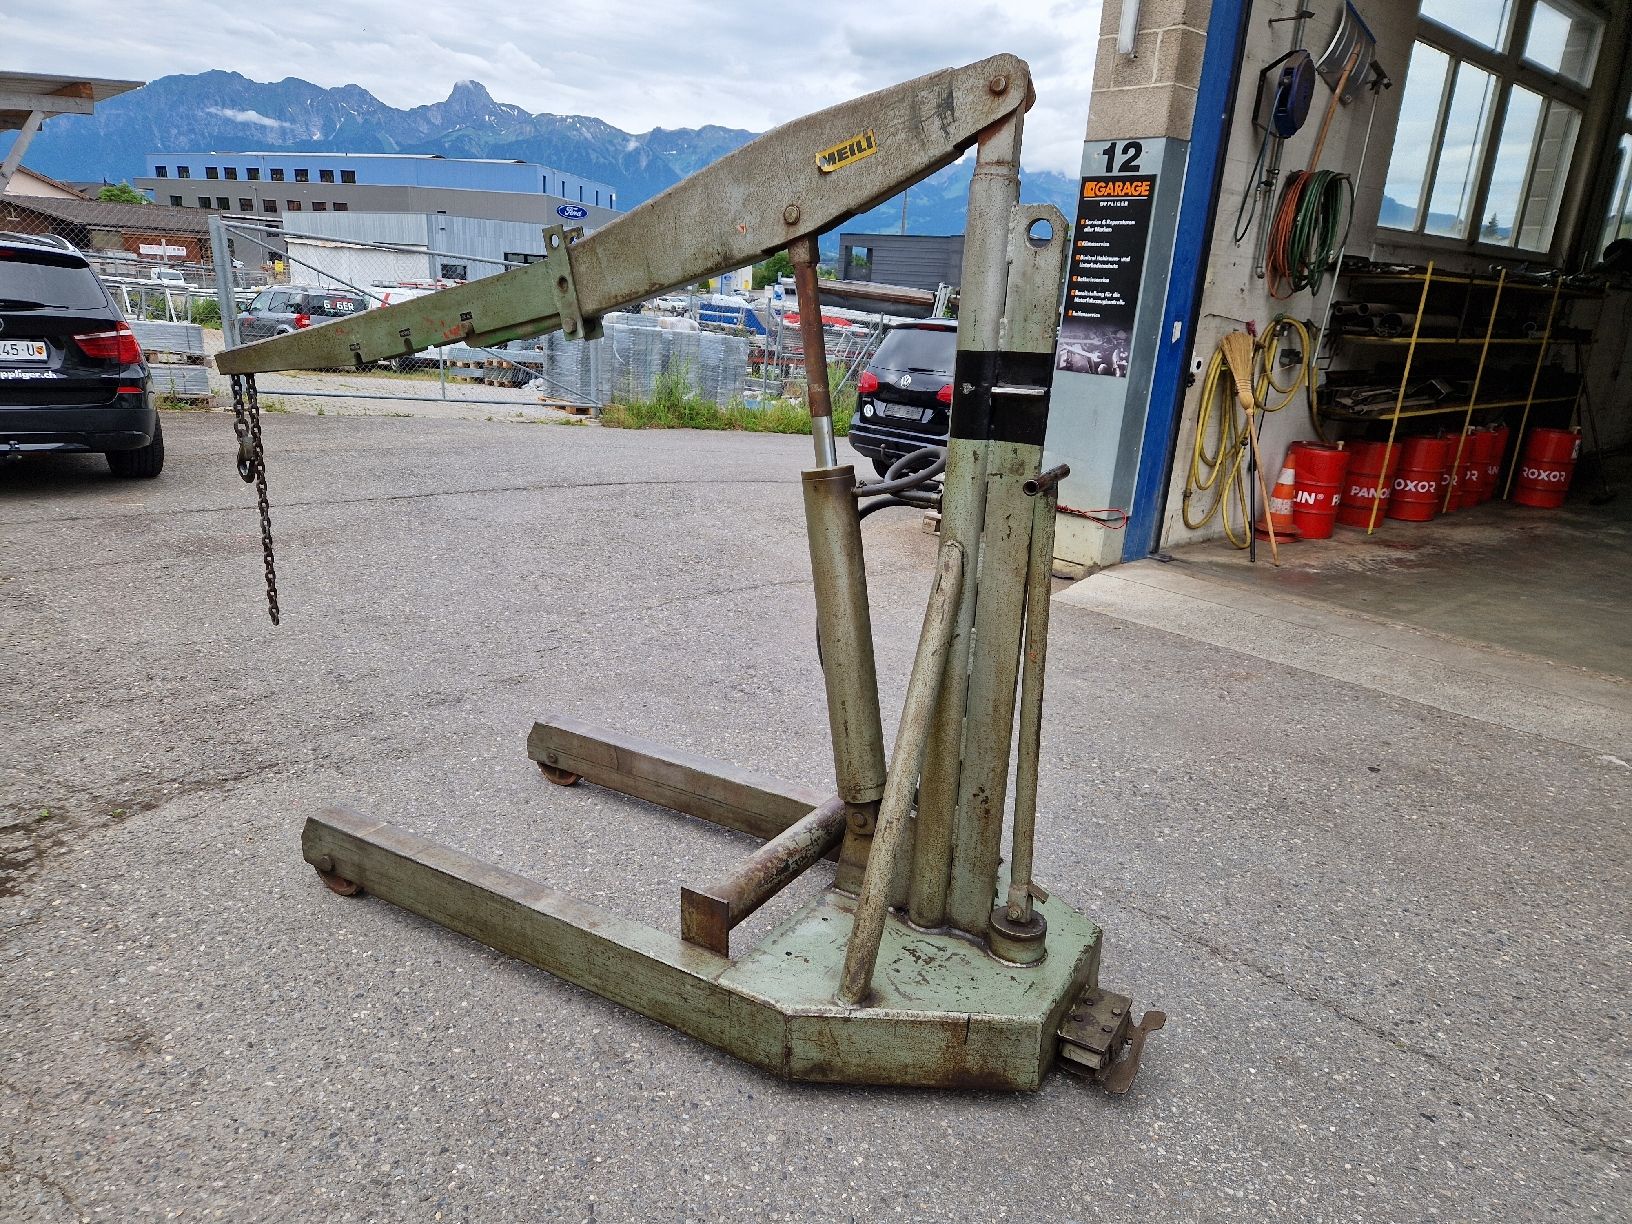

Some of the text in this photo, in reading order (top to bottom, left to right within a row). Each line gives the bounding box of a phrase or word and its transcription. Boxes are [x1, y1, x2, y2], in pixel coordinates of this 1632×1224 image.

[819, 135, 874, 168] MEILI
[1102, 141, 1143, 173] 12
[1095, 181, 1151, 196] GARAGE
[564, 206, 583, 217] Ford
